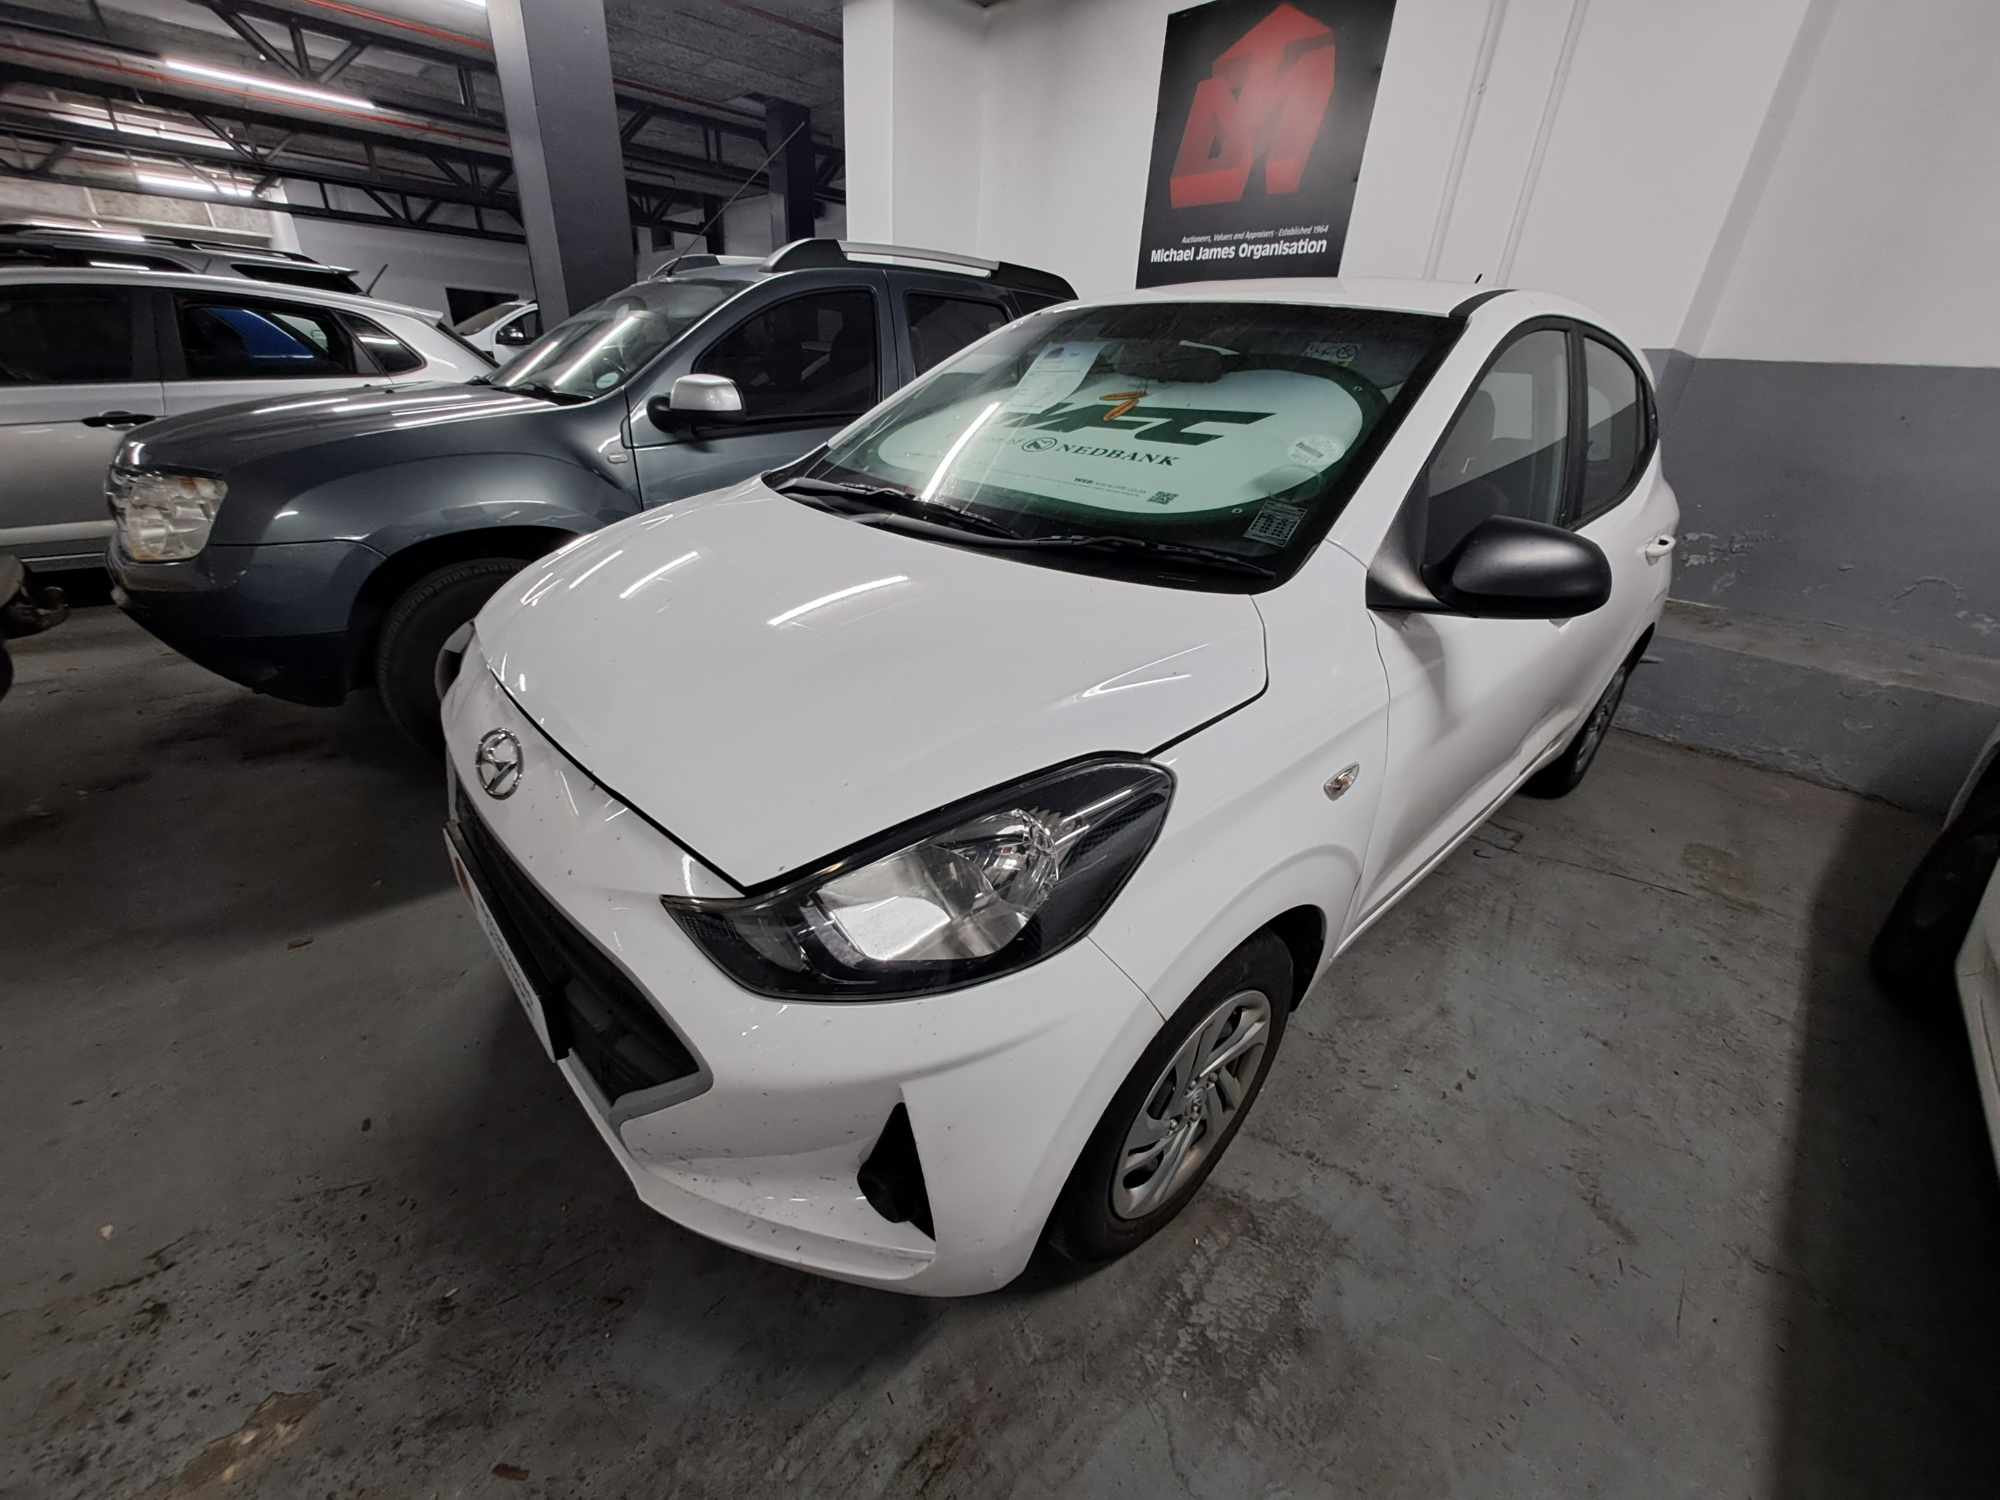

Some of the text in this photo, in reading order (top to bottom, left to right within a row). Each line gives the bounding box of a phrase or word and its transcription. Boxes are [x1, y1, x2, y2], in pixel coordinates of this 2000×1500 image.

[1234, 231, 1245, 240] and
[1150, 238, 1328, 262] Michael James Organisation
[1057, 443, 1180, 466] NEDBANK
